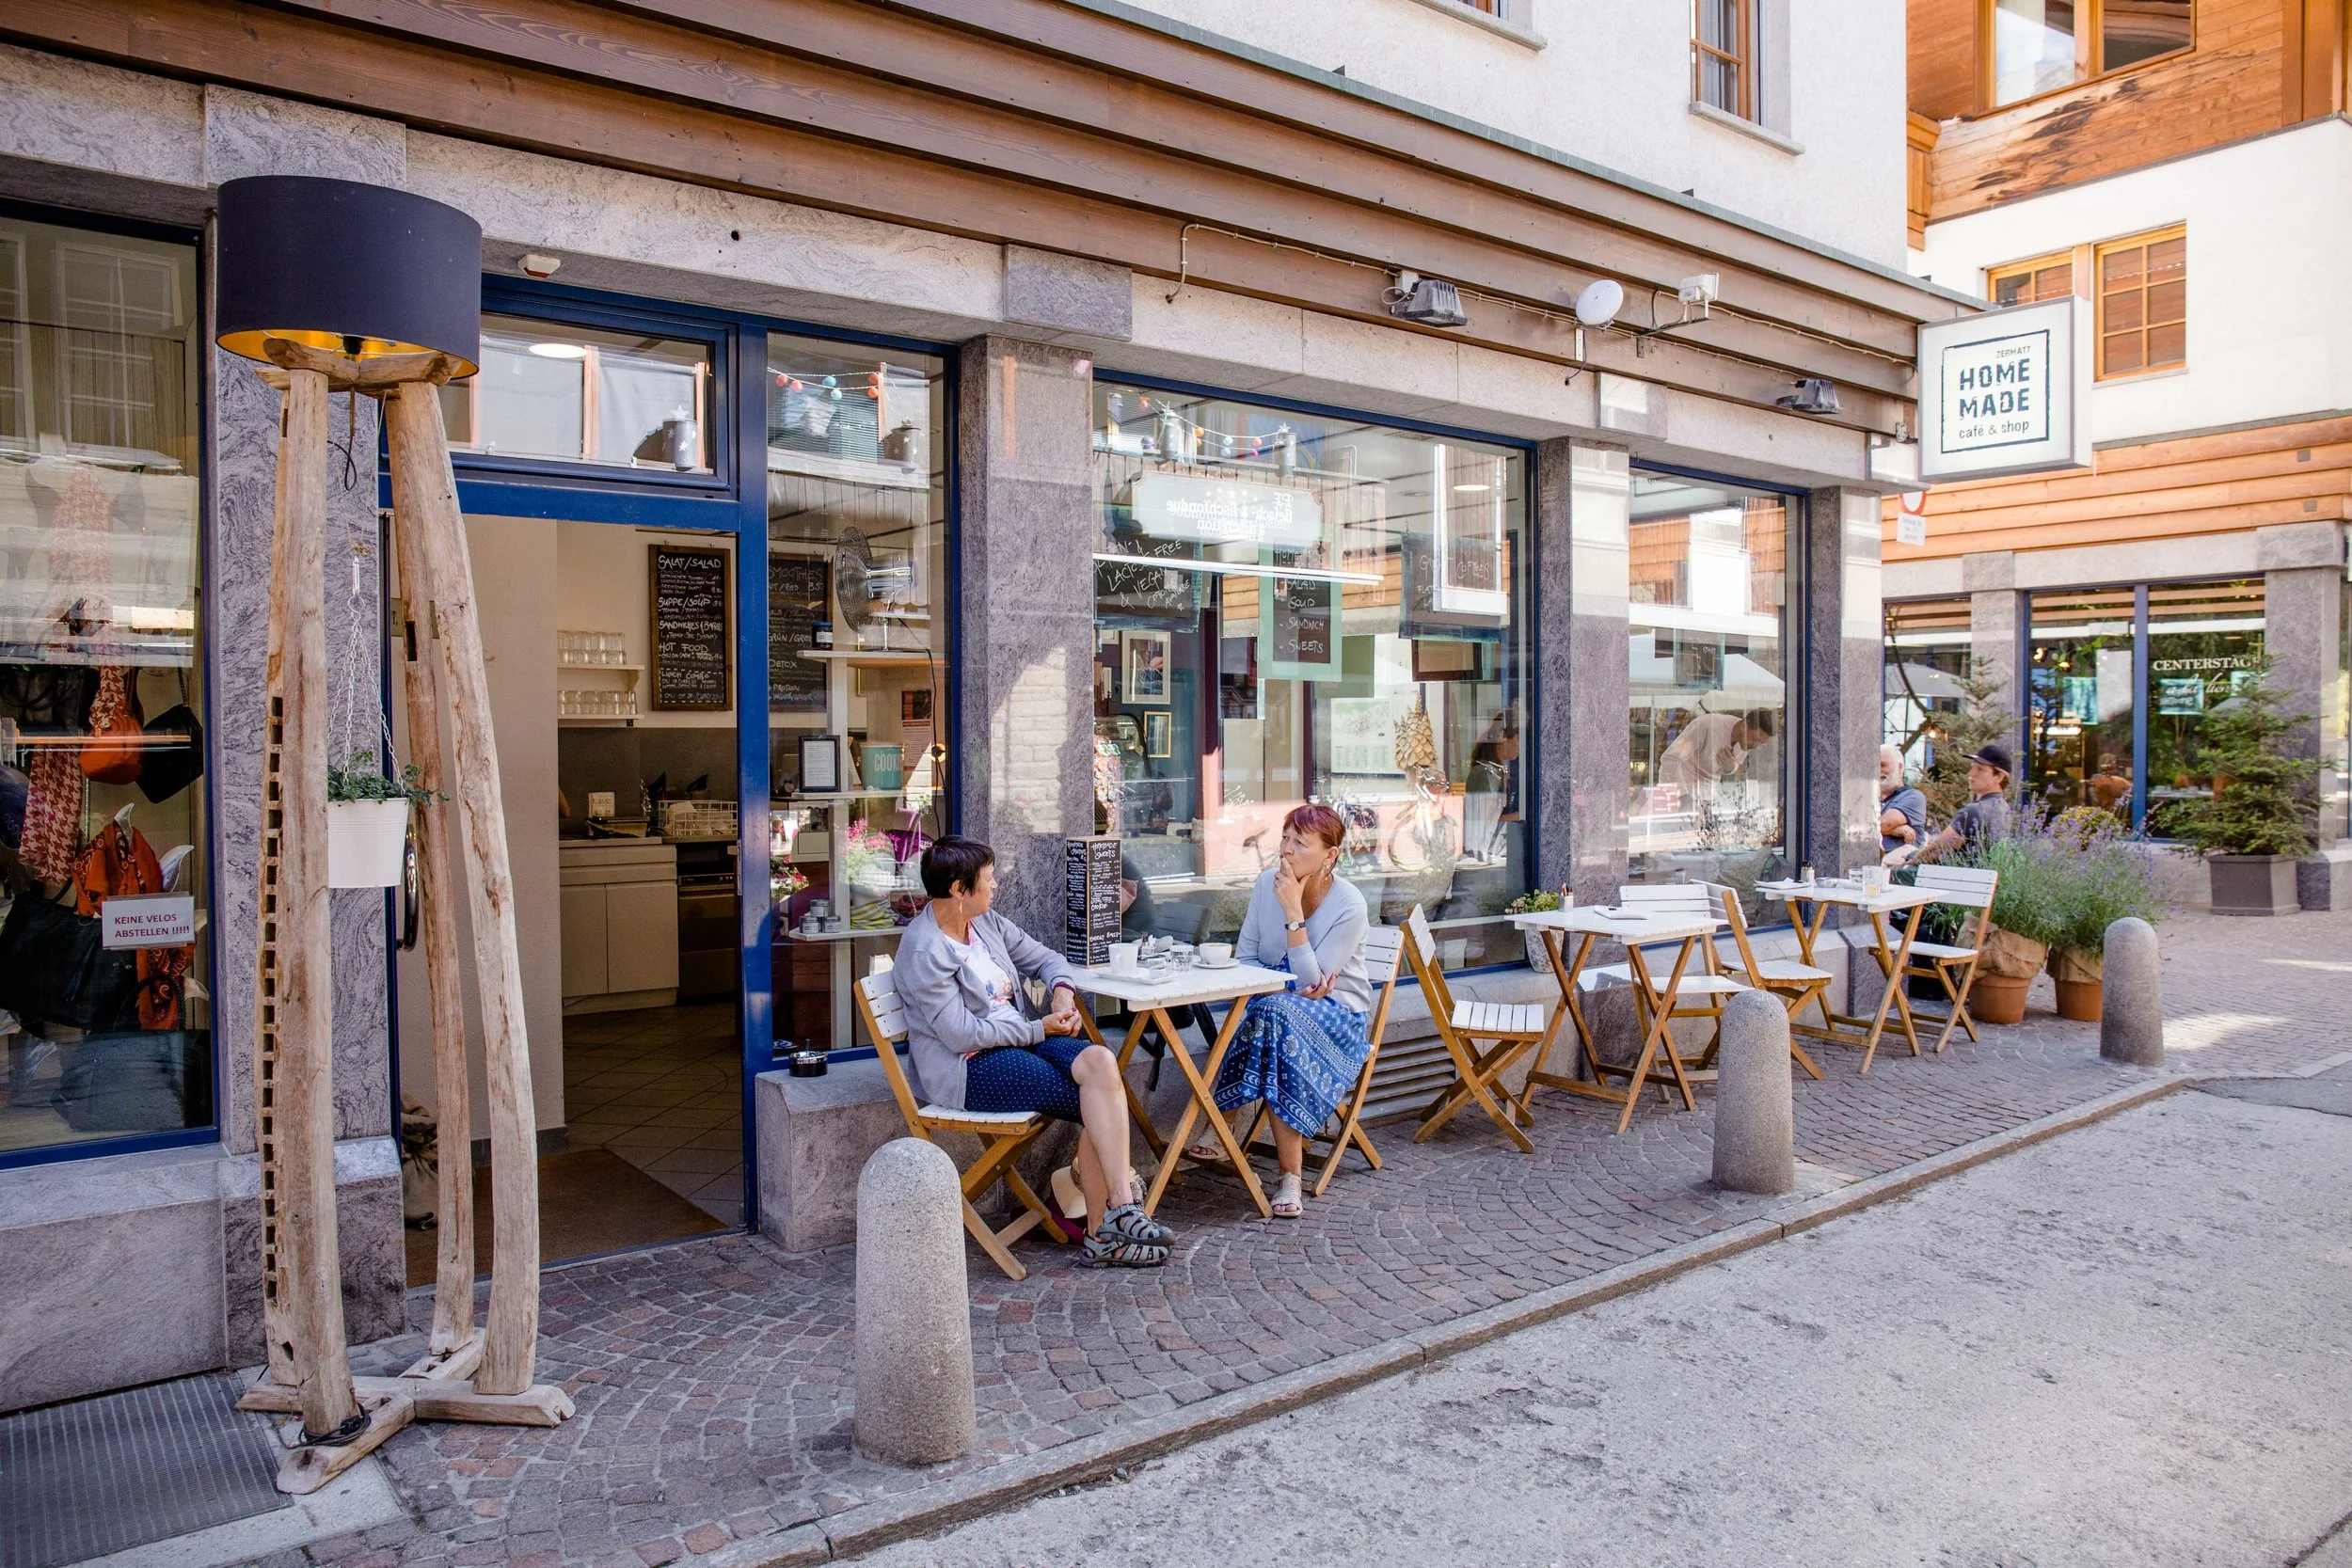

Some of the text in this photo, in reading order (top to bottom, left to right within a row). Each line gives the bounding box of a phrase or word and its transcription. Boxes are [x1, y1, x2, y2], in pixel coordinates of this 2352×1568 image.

[1995, 345, 2031, 358] ZERMATT
[1960, 358, 2030, 390] HOME
[1960, 388, 2030, 420] MADE
[1959, 420, 2029, 439] café & shop
[1153, 539, 1183, 557] FREE
[1287, 595, 1315, 610] SOUP
[659, 641, 709, 653] HOT FOOD
[1287, 639, 1324, 654] SWEETS
[768, 658, 798, 669] DETOX
[114, 913, 177, 925] KEINE VELOS
[114, 927, 169, 938] ABSTELLEN
